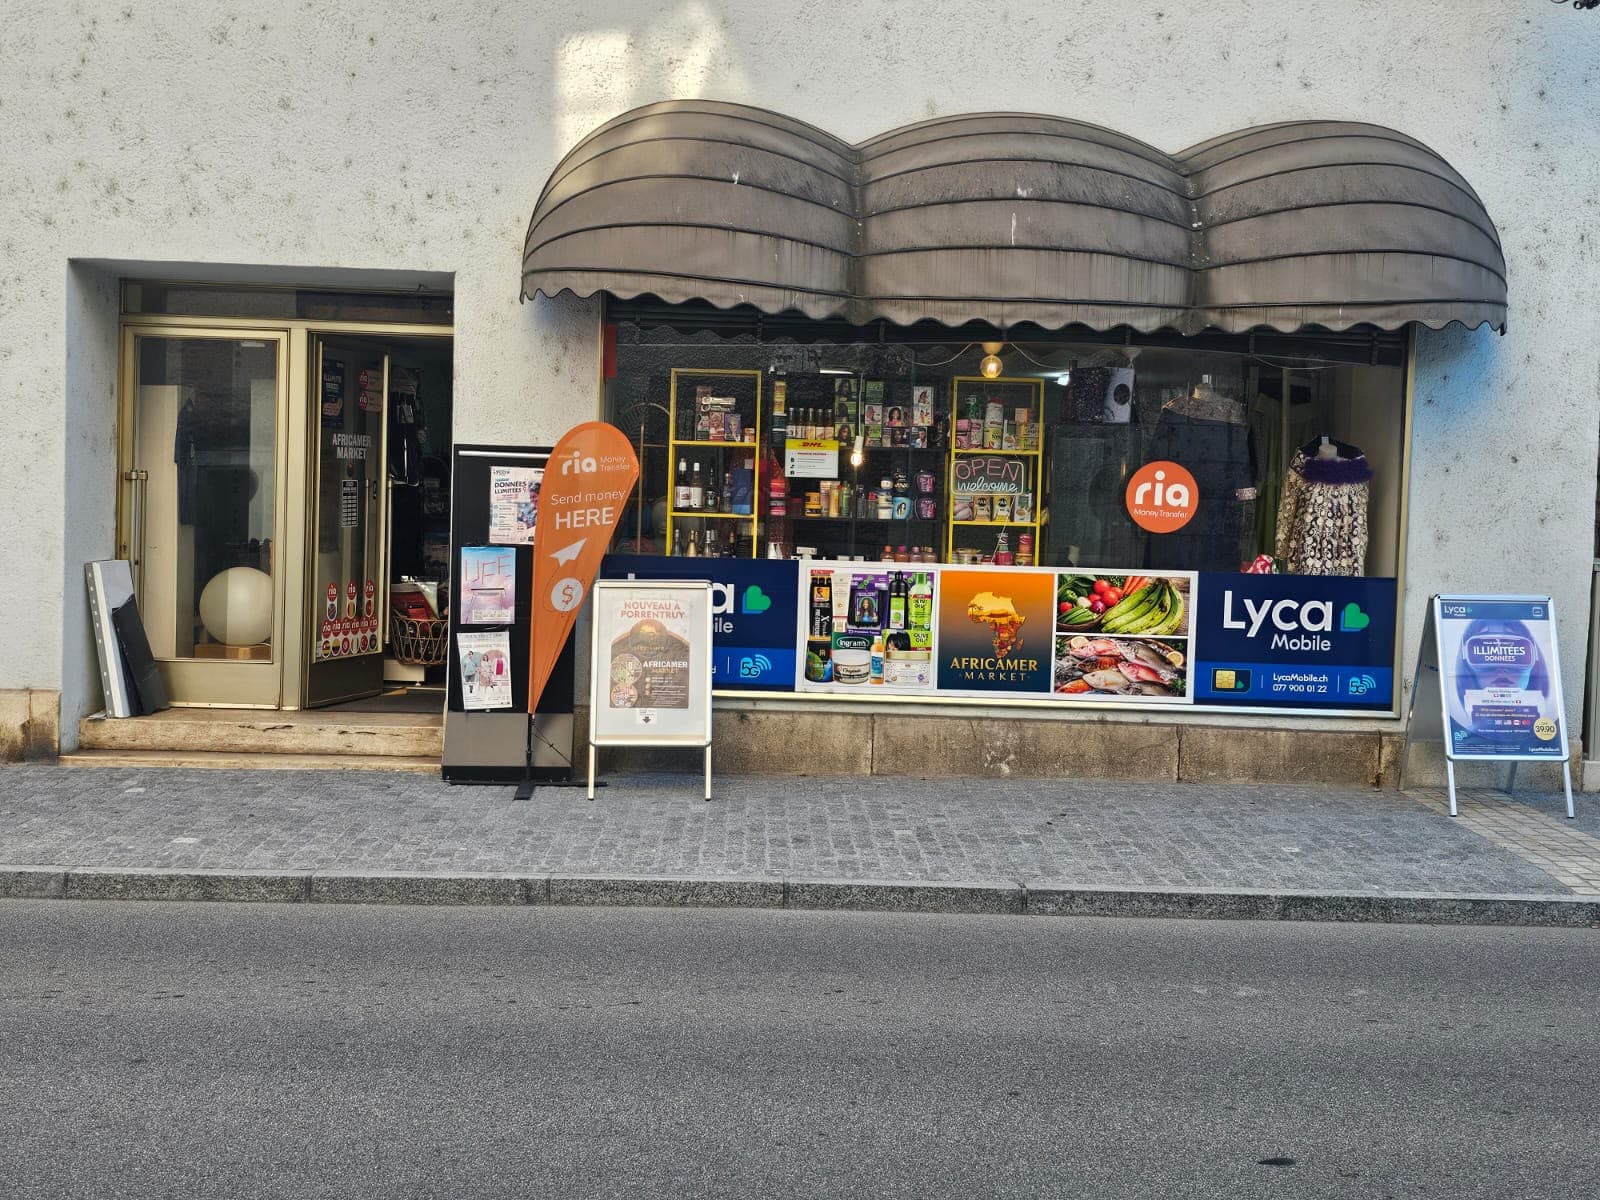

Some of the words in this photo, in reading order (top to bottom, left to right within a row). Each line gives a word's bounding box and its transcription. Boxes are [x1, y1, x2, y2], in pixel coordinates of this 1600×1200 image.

[332, 433, 371, 447] AFRICAMER
[337, 447, 367, 459] MARKET
[562, 451, 597, 475] ria
[955, 458, 1020, 481] OPEN
[957, 476, 1018, 493] welcome
[1135, 470, 1189, 507] ria
[551, 491, 582, 506] Send
[585, 490, 626, 503] money
[555, 507, 614, 530] HERE
[1133, 508, 1159, 518] Money
[1160, 510, 1187, 518] Transfer
[624, 601, 671, 610] NOUVEAU
[1444, 605, 1466, 614] Lyca
[620, 610, 685, 619] PORRENTRUY
[1223, 590, 1333, 637] Lyca
[1270, 634, 1331, 651] Mobile
[643, 660, 688, 668] AFRICAMER
[741, 660, 761, 677] 5G
[950, 657, 1038, 671] AFRICAMER
[964, 671, 1027, 681] MARKET
[1273, 672, 1329, 683] LycaMobile.ch
[1272, 684, 1287, 692] 077
[1289, 684, 1305, 692] 900
[1306, 684, 1315, 693] 01
[1317, 685, 1328, 693] 22
[1535, 725, 1555, 733] 39.90
